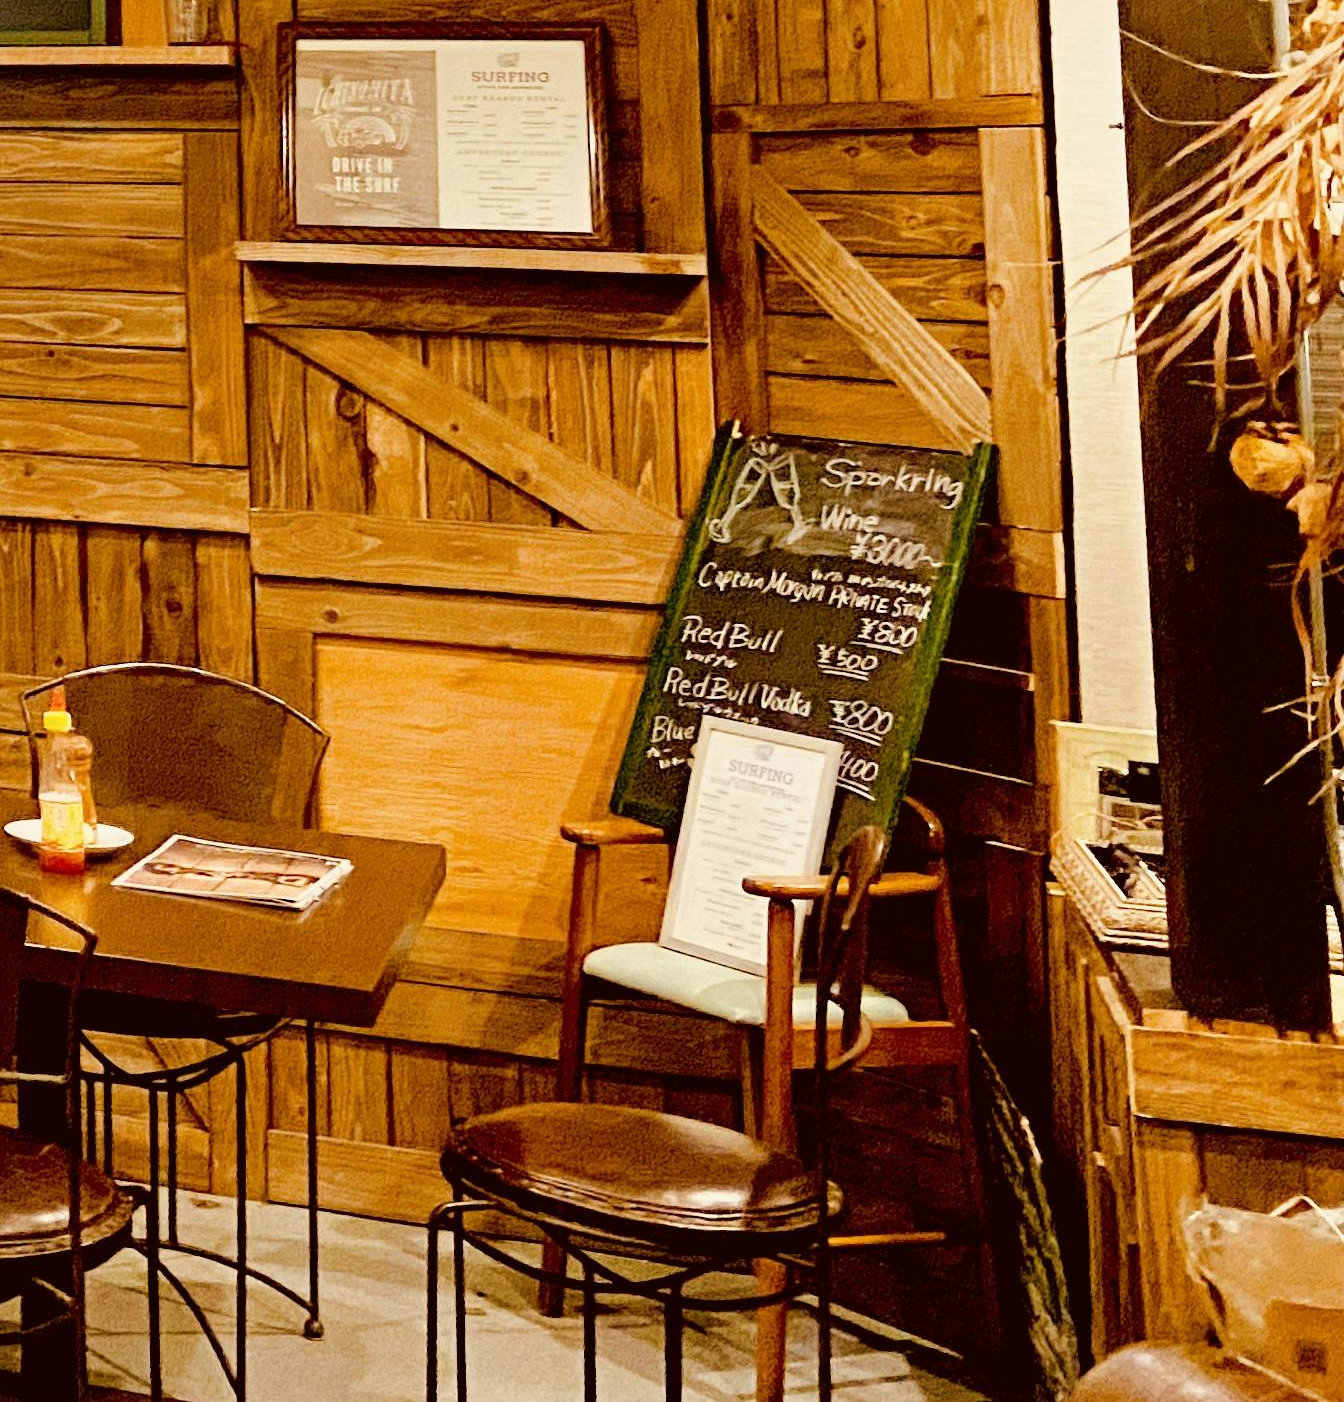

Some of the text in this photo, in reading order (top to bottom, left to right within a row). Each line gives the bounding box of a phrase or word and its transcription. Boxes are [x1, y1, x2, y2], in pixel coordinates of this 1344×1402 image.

[470, 70, 550, 84] SURFING
[331, 156, 372, 174] DRIVE
[334, 176, 401, 194] THE SURF
[820, 504, 880, 533] Wine
[760, 683, 812, 718] Vodka
[650, 714, 696, 742] Blue
[727, 759, 795, 786] SURFING
